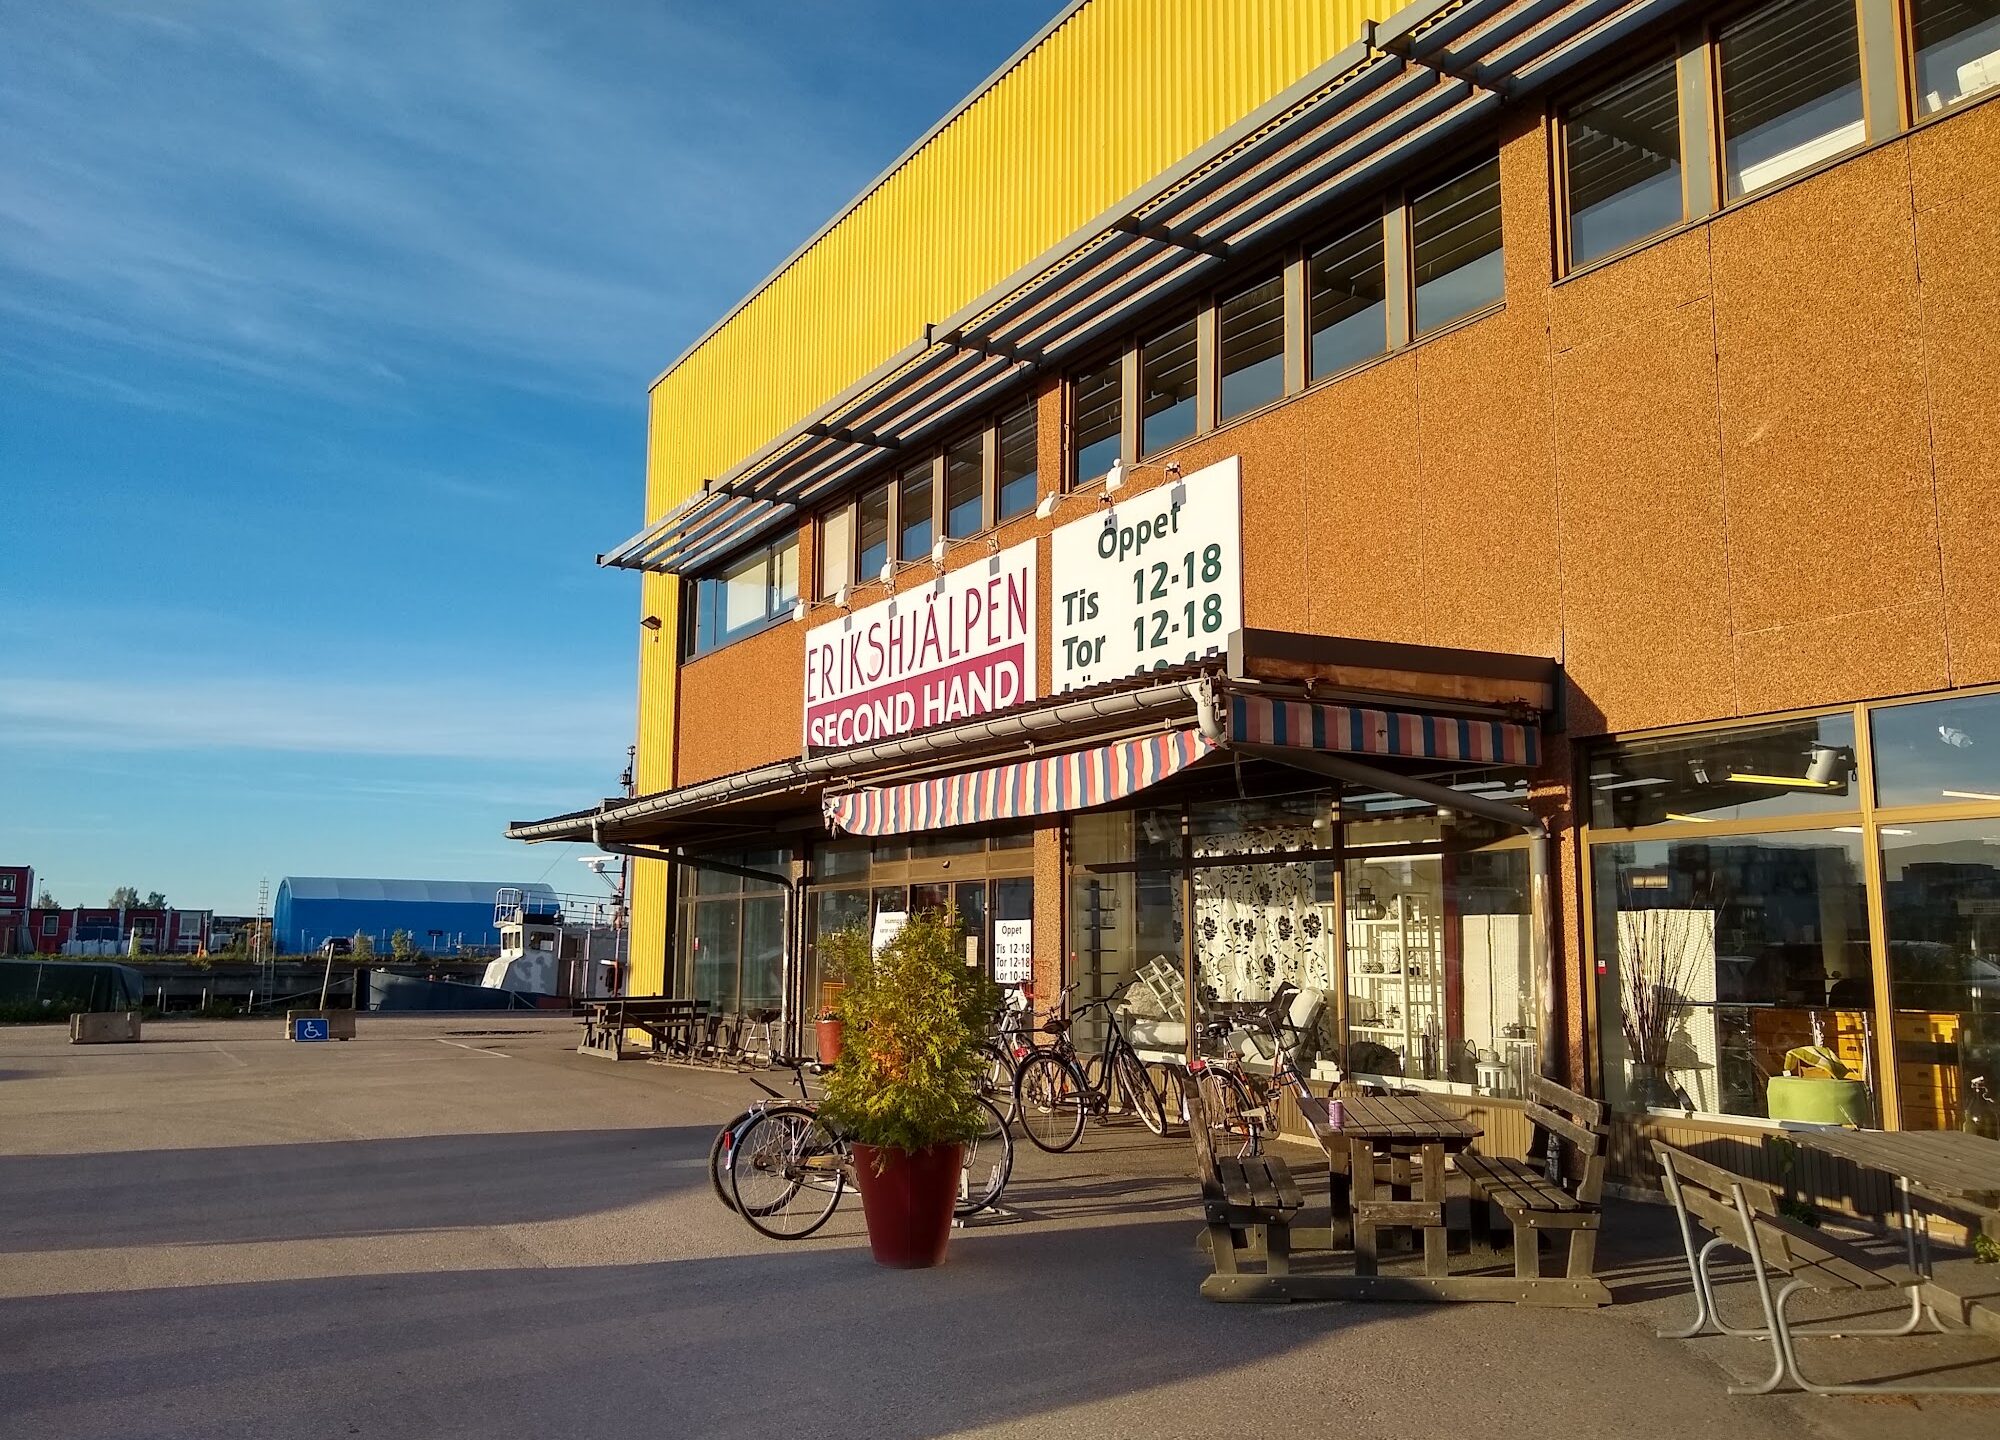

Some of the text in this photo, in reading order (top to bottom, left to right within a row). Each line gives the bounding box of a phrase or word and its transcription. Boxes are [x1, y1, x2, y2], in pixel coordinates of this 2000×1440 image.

[1097, 501, 1181, 563] Öppet
[1062, 543, 1222, 626] Tis 12-18
[807, 567, 1028, 703] ERIKSHJÄLPEN
[1062, 635, 1106, 671] Tor
[1133, 593, 1223, 653] 12-18
[811, 660, 1020, 747] SECOND HAND
[996, 943, 1030, 954] Tis 12-18
[1001, 923, 1022, 937] Öppet
[996, 957, 1030, 968] Tor 12-18
[996, 970, 1030, 981] Lör 10-15
